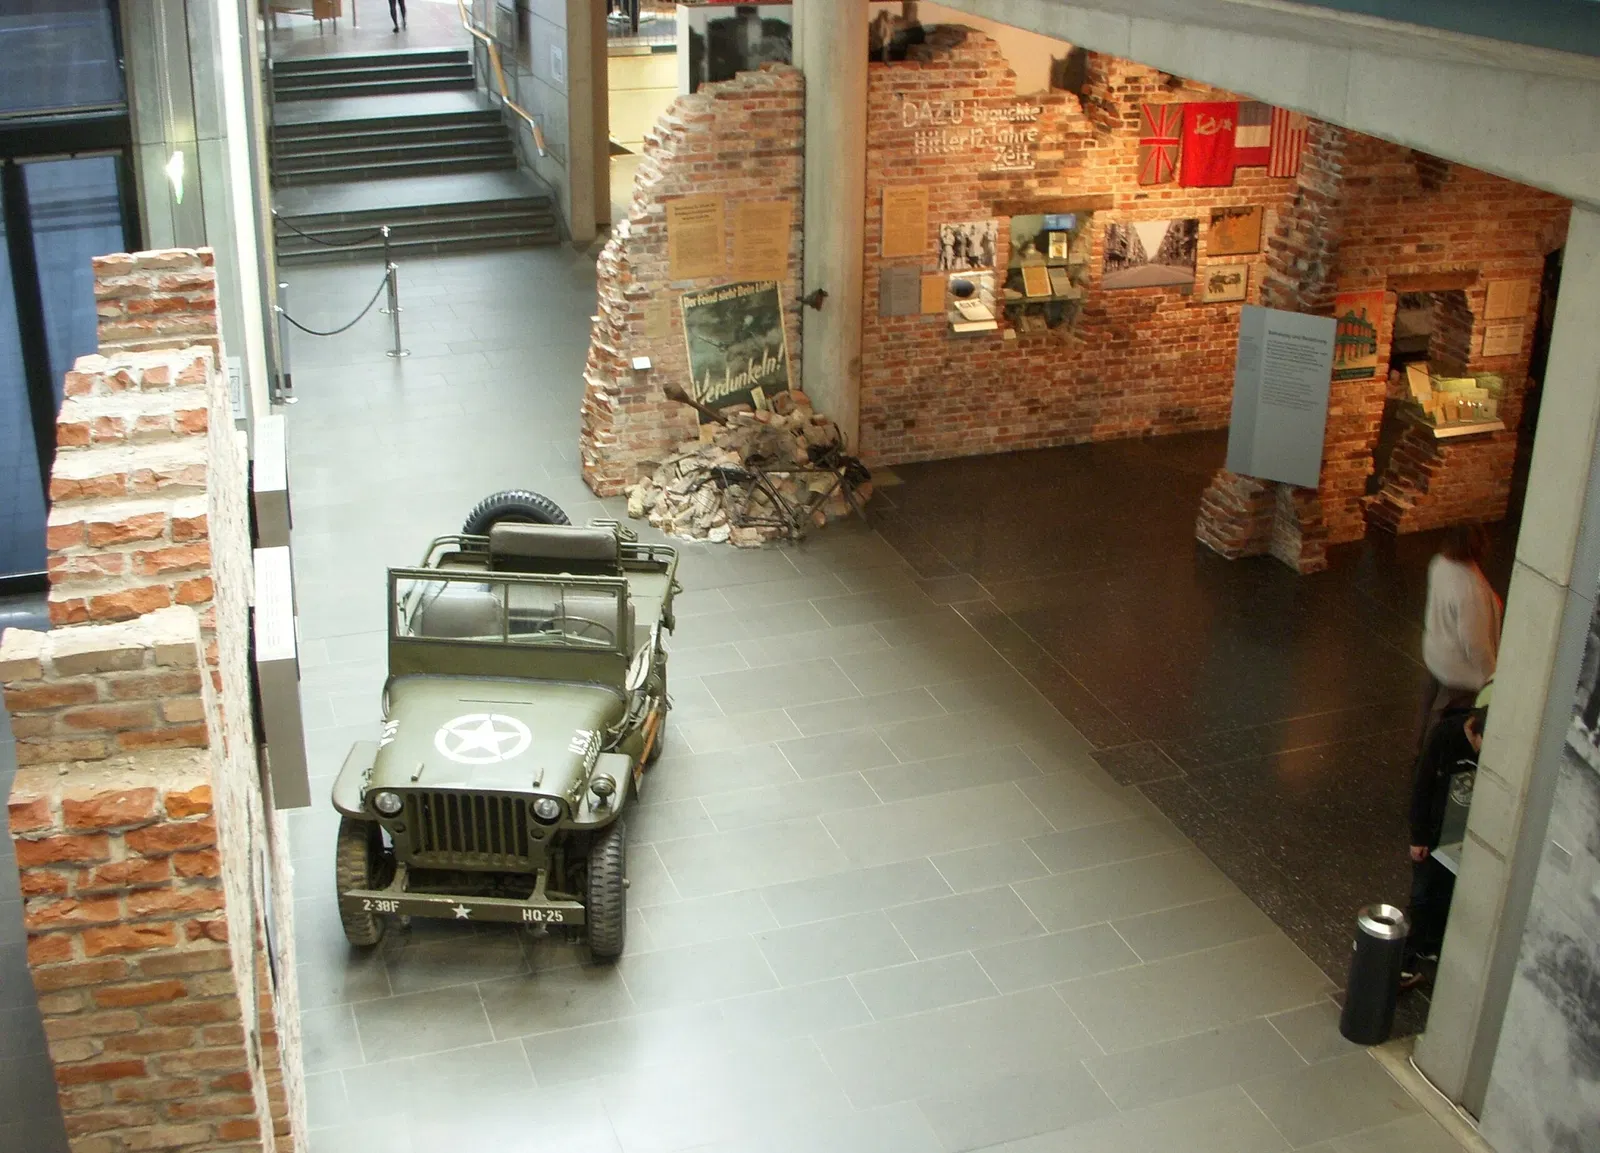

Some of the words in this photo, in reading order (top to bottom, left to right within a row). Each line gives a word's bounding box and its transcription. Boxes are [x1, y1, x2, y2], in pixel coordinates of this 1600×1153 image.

[902, 100, 964, 128] DAZU
[973, 100, 1041, 122] brauchte
[914, 129, 967, 155] Hitler
[695, 342, 785, 406] Verdunkeln!
[522, 908, 564, 922] HQ-25
